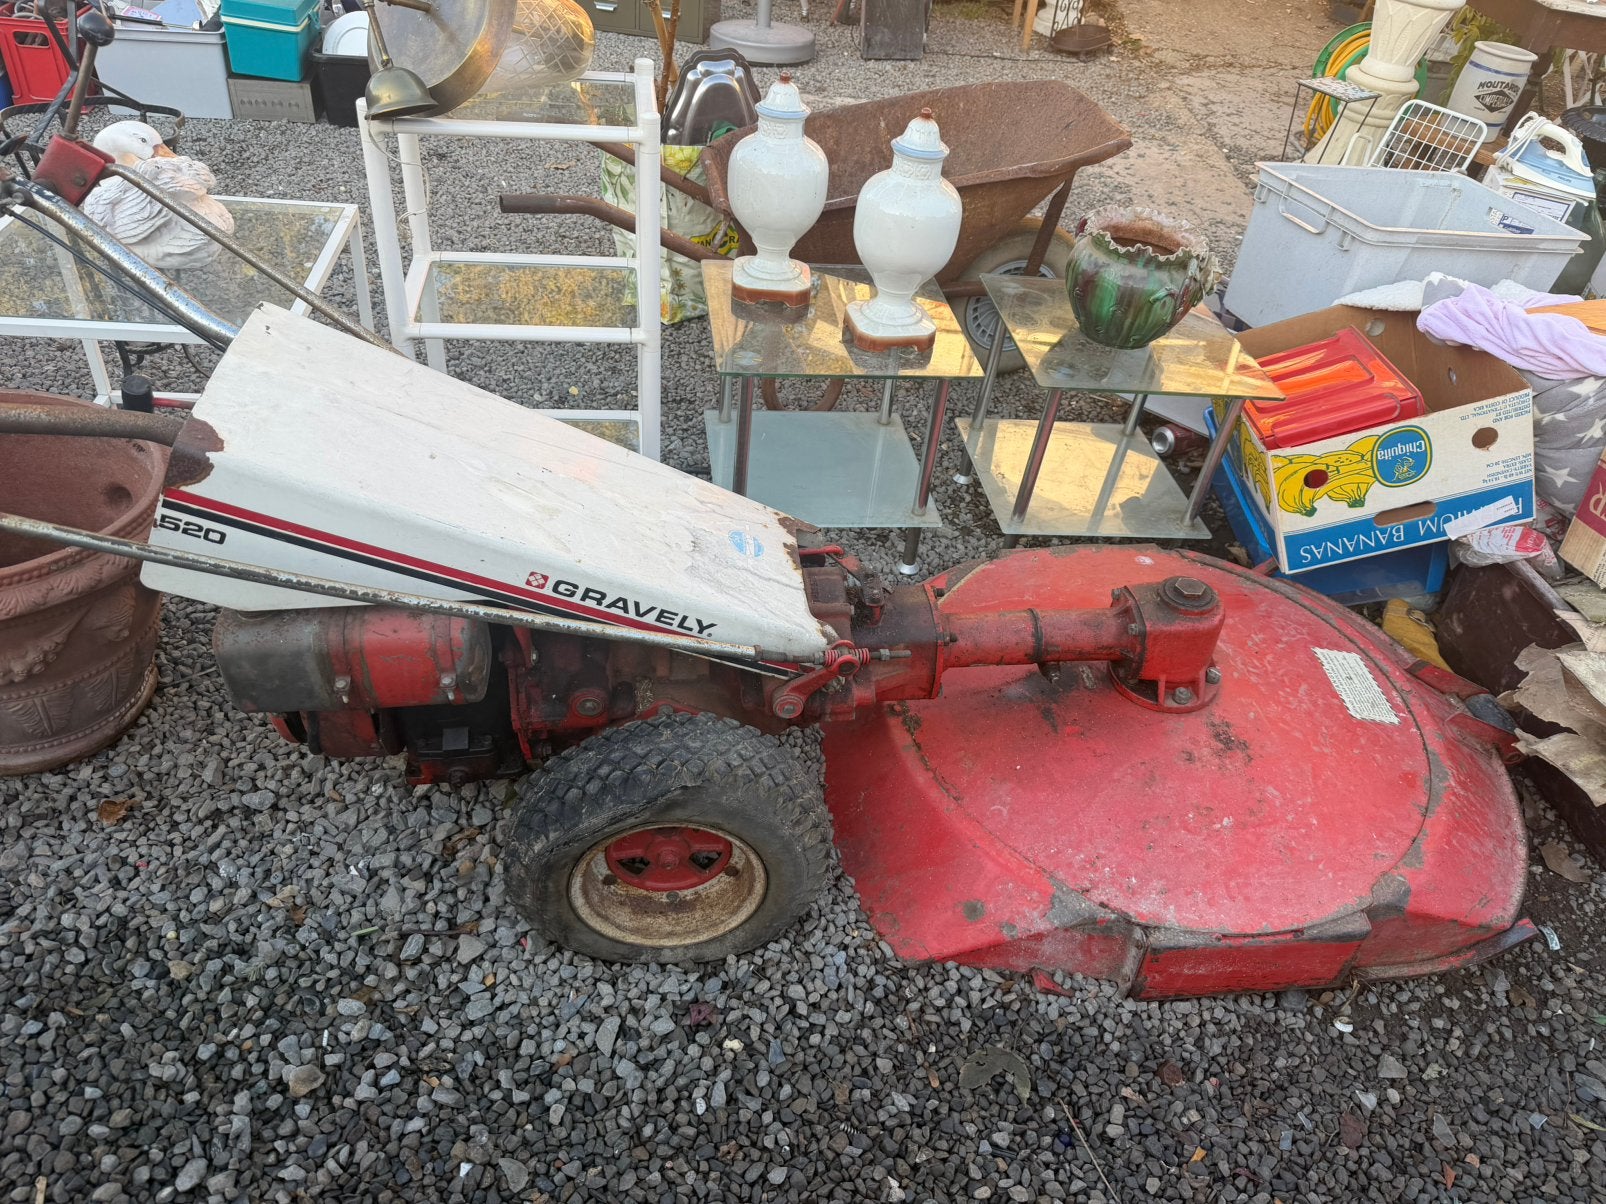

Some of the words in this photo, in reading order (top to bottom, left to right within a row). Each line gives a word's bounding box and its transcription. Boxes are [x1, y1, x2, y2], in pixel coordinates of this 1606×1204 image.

[1377, 440, 1426, 460] Chiquita
[158, 513, 227, 545] 520
[1299, 524, 1405, 563] BANANAS
[551, 578, 719, 634] GRAVELY
